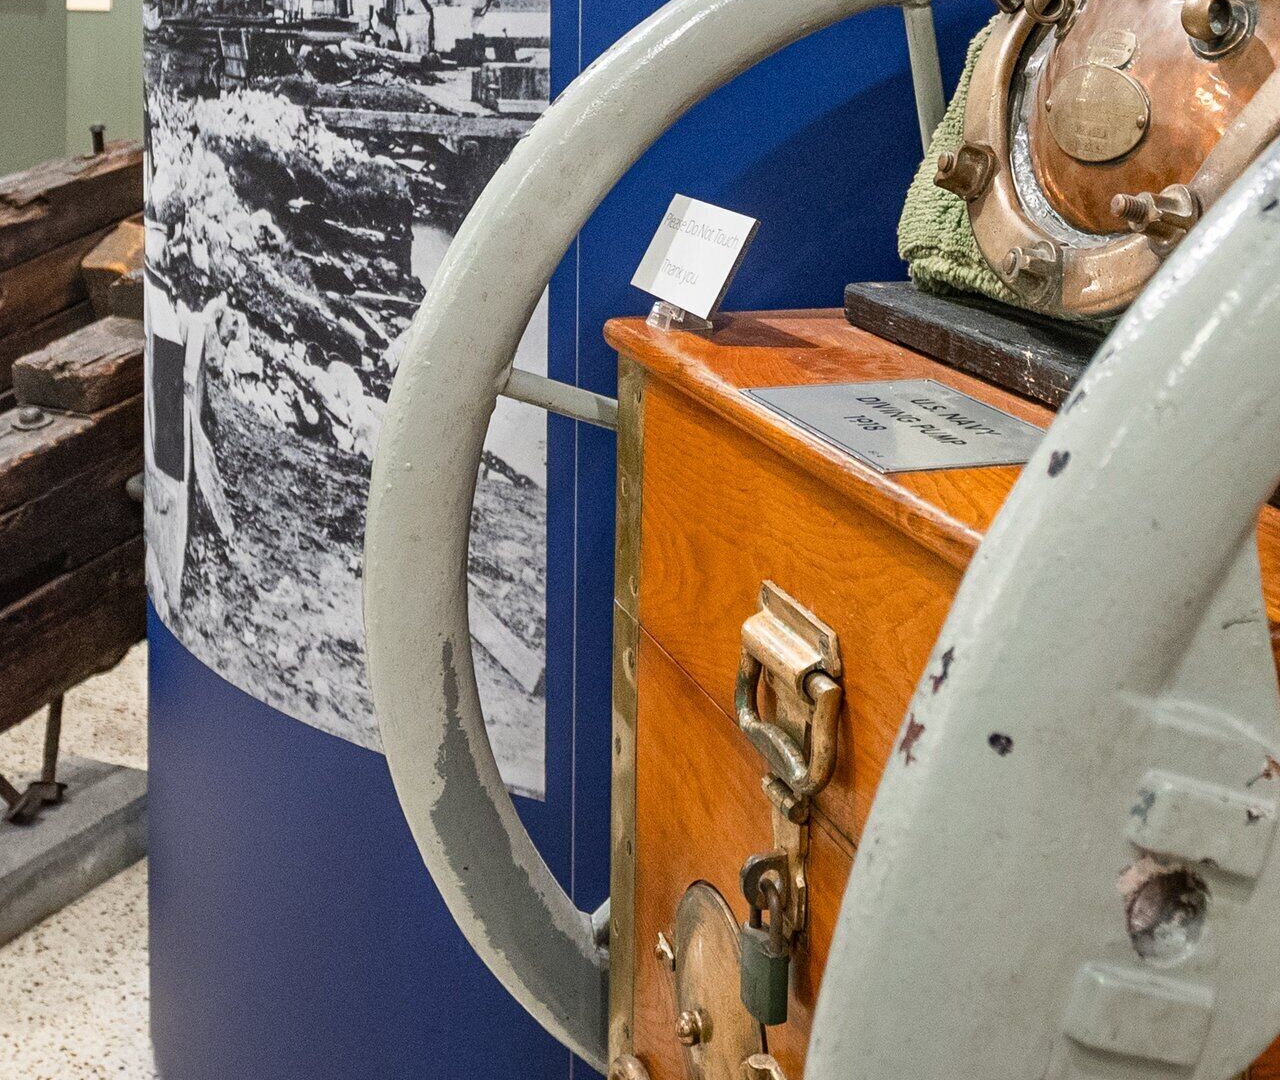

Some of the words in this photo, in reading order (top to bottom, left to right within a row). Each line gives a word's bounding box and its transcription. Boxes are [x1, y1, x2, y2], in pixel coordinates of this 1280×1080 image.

[663, 212, 688, 233] Please
[685, 219, 700, 238] Do
[698, 223, 716, 242] Not
[714, 228, 741, 250] Touch
[661, 258, 682, 280] Thank
[679, 270, 700, 286] you
[843, 414, 888, 432] 1918
[855, 396, 922, 423] DIVING
[909, 423, 968, 446] PUMP
[938, 413, 1003, 436] NAVY
